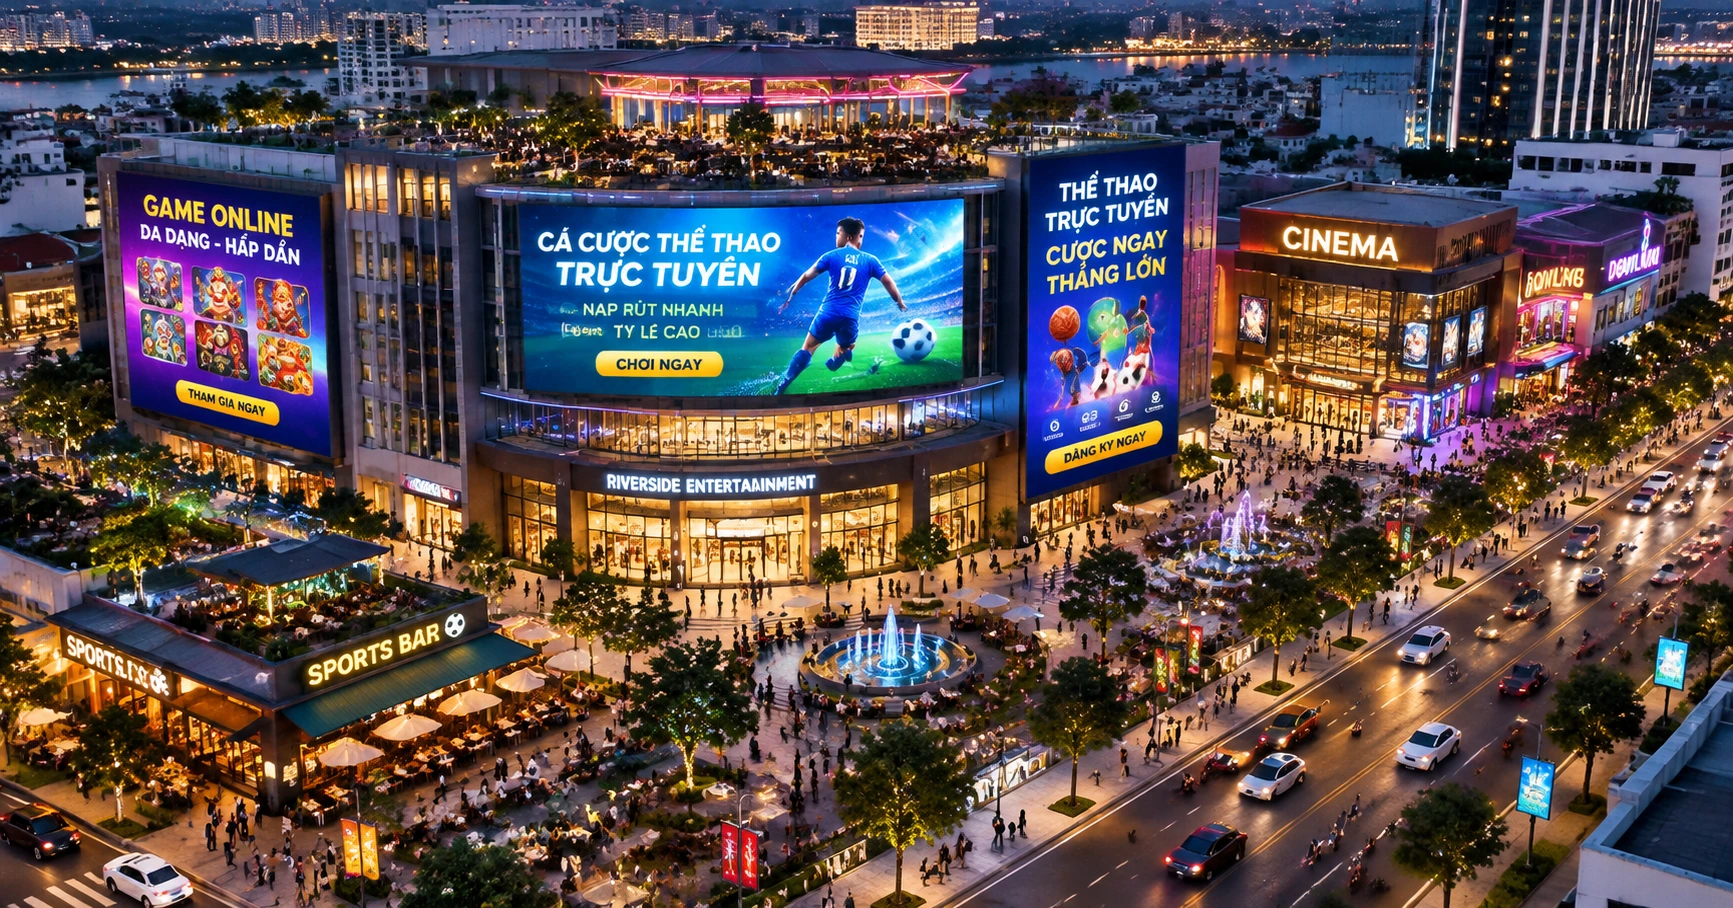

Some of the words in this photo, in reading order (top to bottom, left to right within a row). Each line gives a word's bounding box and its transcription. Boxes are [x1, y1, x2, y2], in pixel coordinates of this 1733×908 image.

[1103, 173, 1158, 196] THAO
[143, 194, 206, 225] GAME
[211, 204, 294, 238] ONLINE
[165, 227, 210, 250] DẠNG
[711, 232, 781, 253] THAO
[1112, 229, 1168, 255] NGAY
[1283, 226, 1399, 262] CINEMA
[556, 259, 644, 293] TRỰC
[662, 303, 724, 316] NHANH
[663, 325, 701, 339] CAO
[659, 359, 703, 370] NGAY
[187, 388, 216, 404] THAM
[218, 396, 235, 409] GIA
[237, 401, 266, 417] NGAY
[1116, 431, 1147, 449] NGAY
[607, 474, 682, 493] RIVERSIDE
[308, 639, 394, 686] SPORTS
[398, 623, 441, 655] BAR
